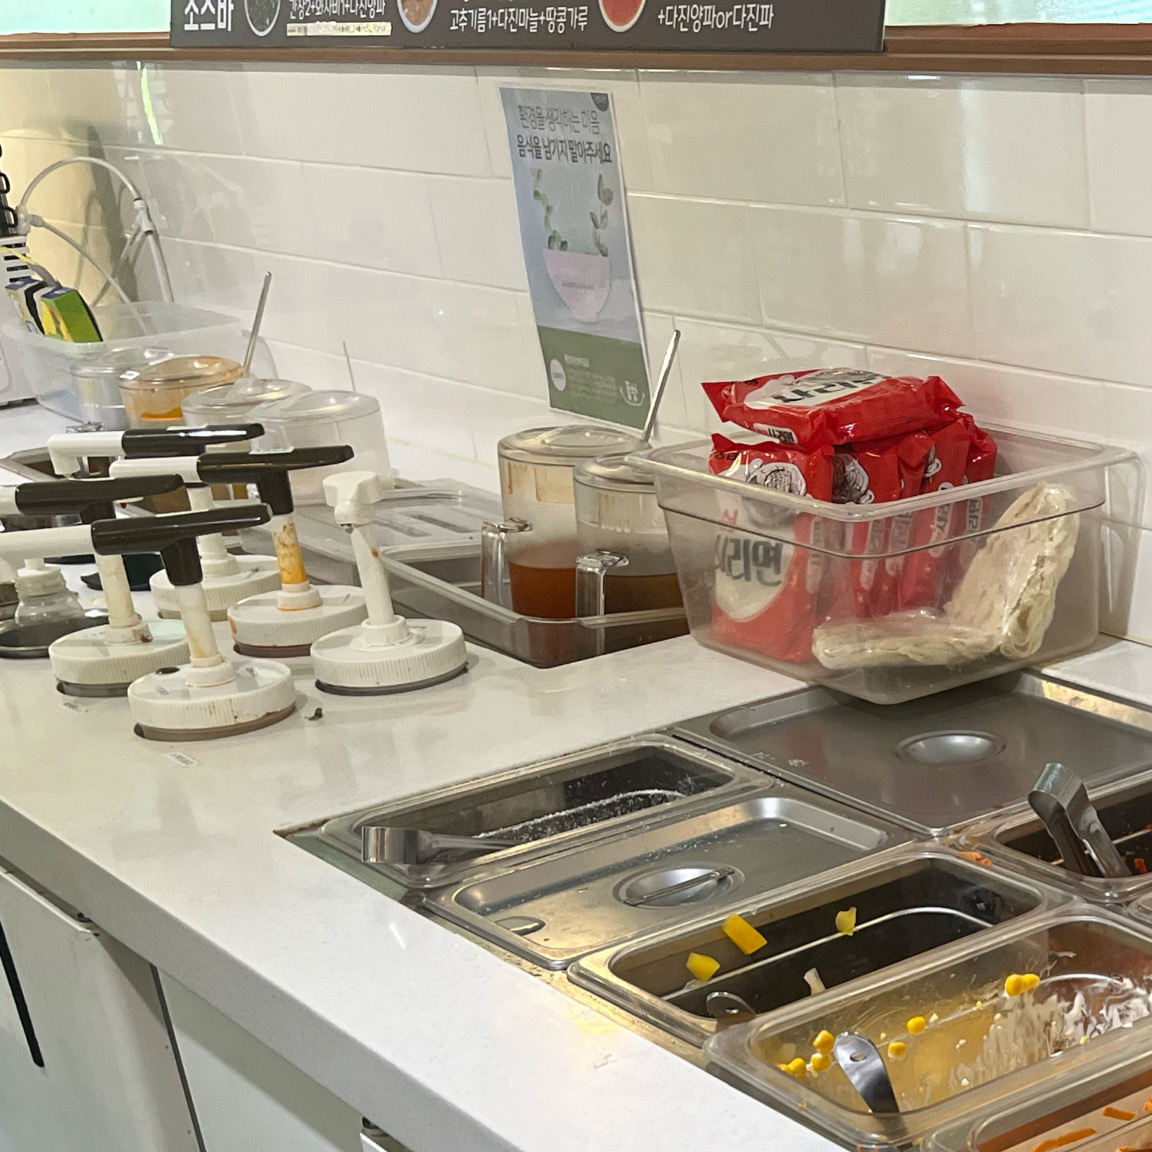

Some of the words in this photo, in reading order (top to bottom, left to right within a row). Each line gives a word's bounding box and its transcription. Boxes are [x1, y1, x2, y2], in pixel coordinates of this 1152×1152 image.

[184, 0, 234, 32] 소스바
[450, 6, 588, 34] 고추기름1+다진마늘+땅콩가루
[658, 4, 774, 33] +다진양파or다진파
[517, 104, 545, 130] 환경을
[545, 107, 580, 134] 생각하는
[581, 110, 600, 135] 마음
[517, 134, 542, 159] 음식을
[542, 137, 569, 162] 남기지
[569, 139, 613, 164] 말아주세요
